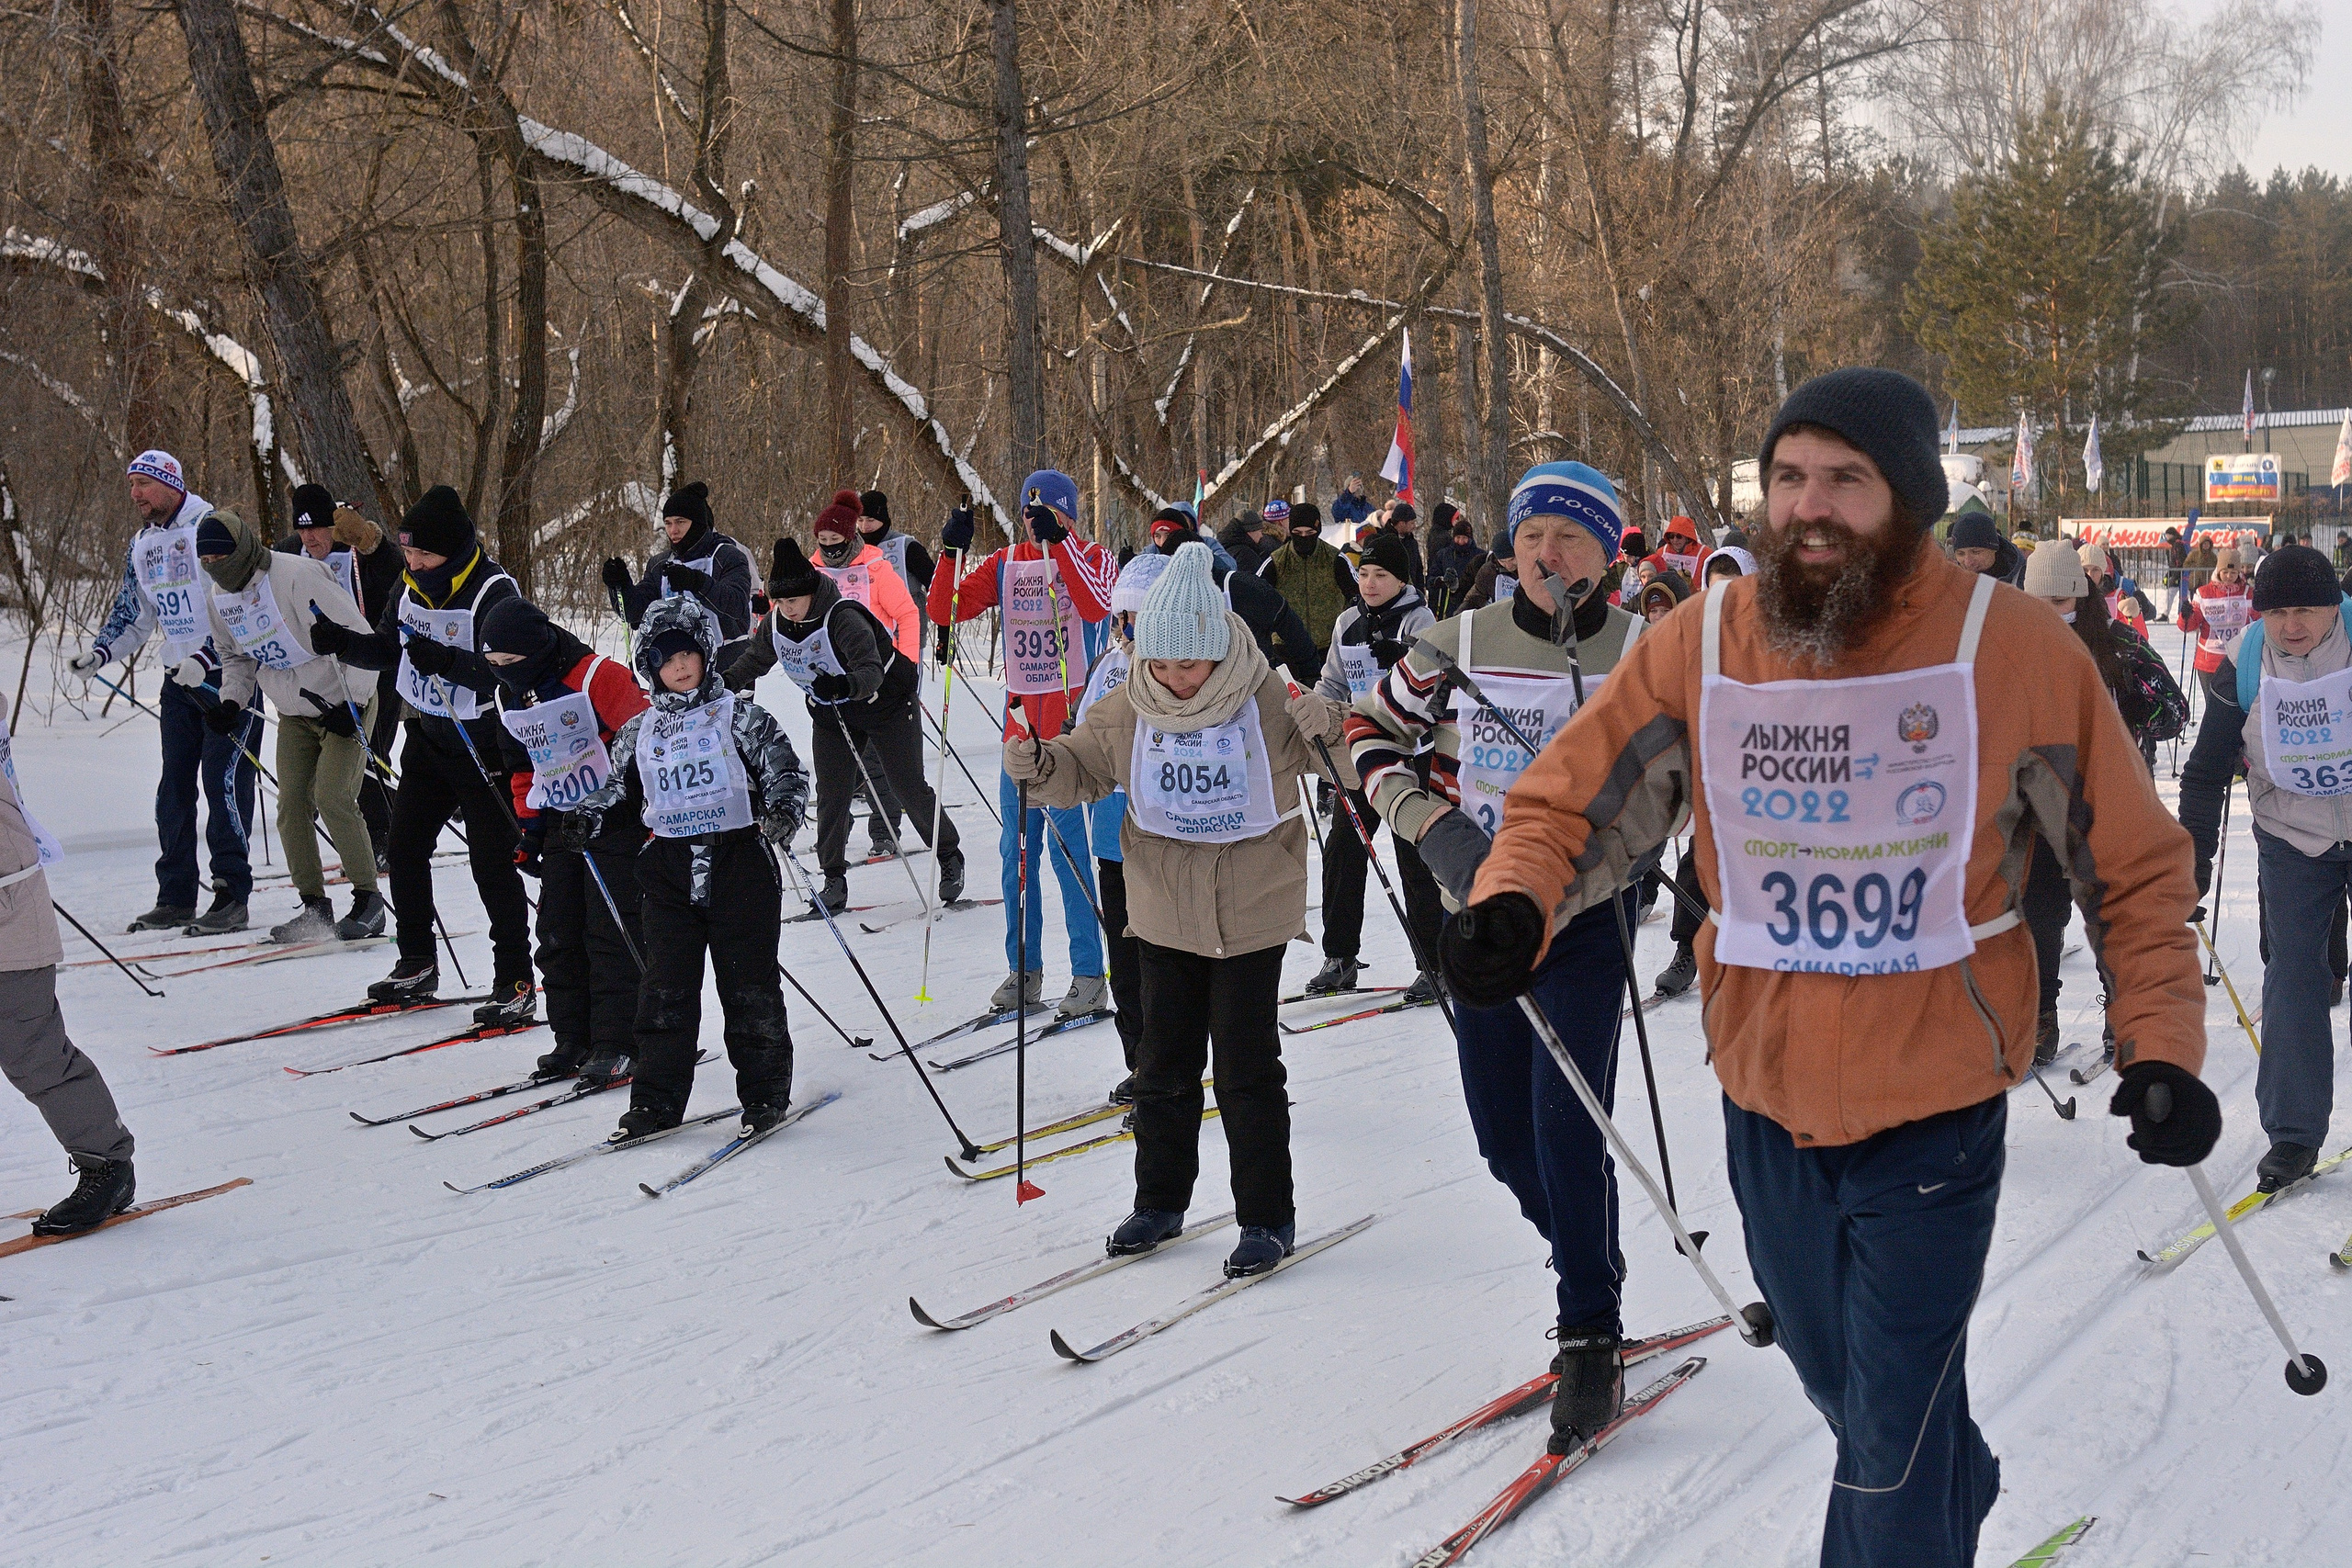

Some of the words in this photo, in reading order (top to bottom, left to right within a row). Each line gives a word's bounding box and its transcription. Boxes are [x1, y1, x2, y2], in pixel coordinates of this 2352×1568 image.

[1547, 495, 1619, 541] РОССИИ
[1013, 576, 1043, 586] ЛЫЖНЯ
[1012, 587, 1043, 598] РОССИИ
[410, 670, 458, 706] 3757
[2278, 712, 2331, 728] РОССИИ
[1174, 739, 1202, 748] РОССИИ
[1740, 723, 1850, 752] ЛЫЖНЯ
[2279, 728, 2334, 745] 2022
[1173, 747, 1203, 758] 2024
[2279, 754, 2309, 763] СПОРТ
[658, 760, 714, 792] 8125
[1741, 753, 1850, 783] РОССИИ
[1160, 761, 1230, 793] 8054
[1476, 779, 1500, 797] СПОРТ
[1741, 787, 1850, 823] 2022
[659, 807, 726, 826] САМАРСКАЯ
[1165, 811, 1246, 827] САМАРСКАЯ
[669, 820, 720, 836] ОБЛАСТЬ
[1745, 839, 1799, 859] СПОРТ
[1812, 845, 1883, 861] НОРМА
[1760, 866, 1926, 950] 3699
[393, 978, 420, 990] ATOMIC
[370, 1004, 401, 1015] ROSSIGNOL
[499, 999, 524, 1016] ATOMIC
[1064, 1014, 1094, 1030] salomon
[479, 1027, 505, 1039] ROSSIGNOL
[614, 1136, 646, 1151] NORDWAY
[1556, 1446, 1585, 1476] ATOMIC
